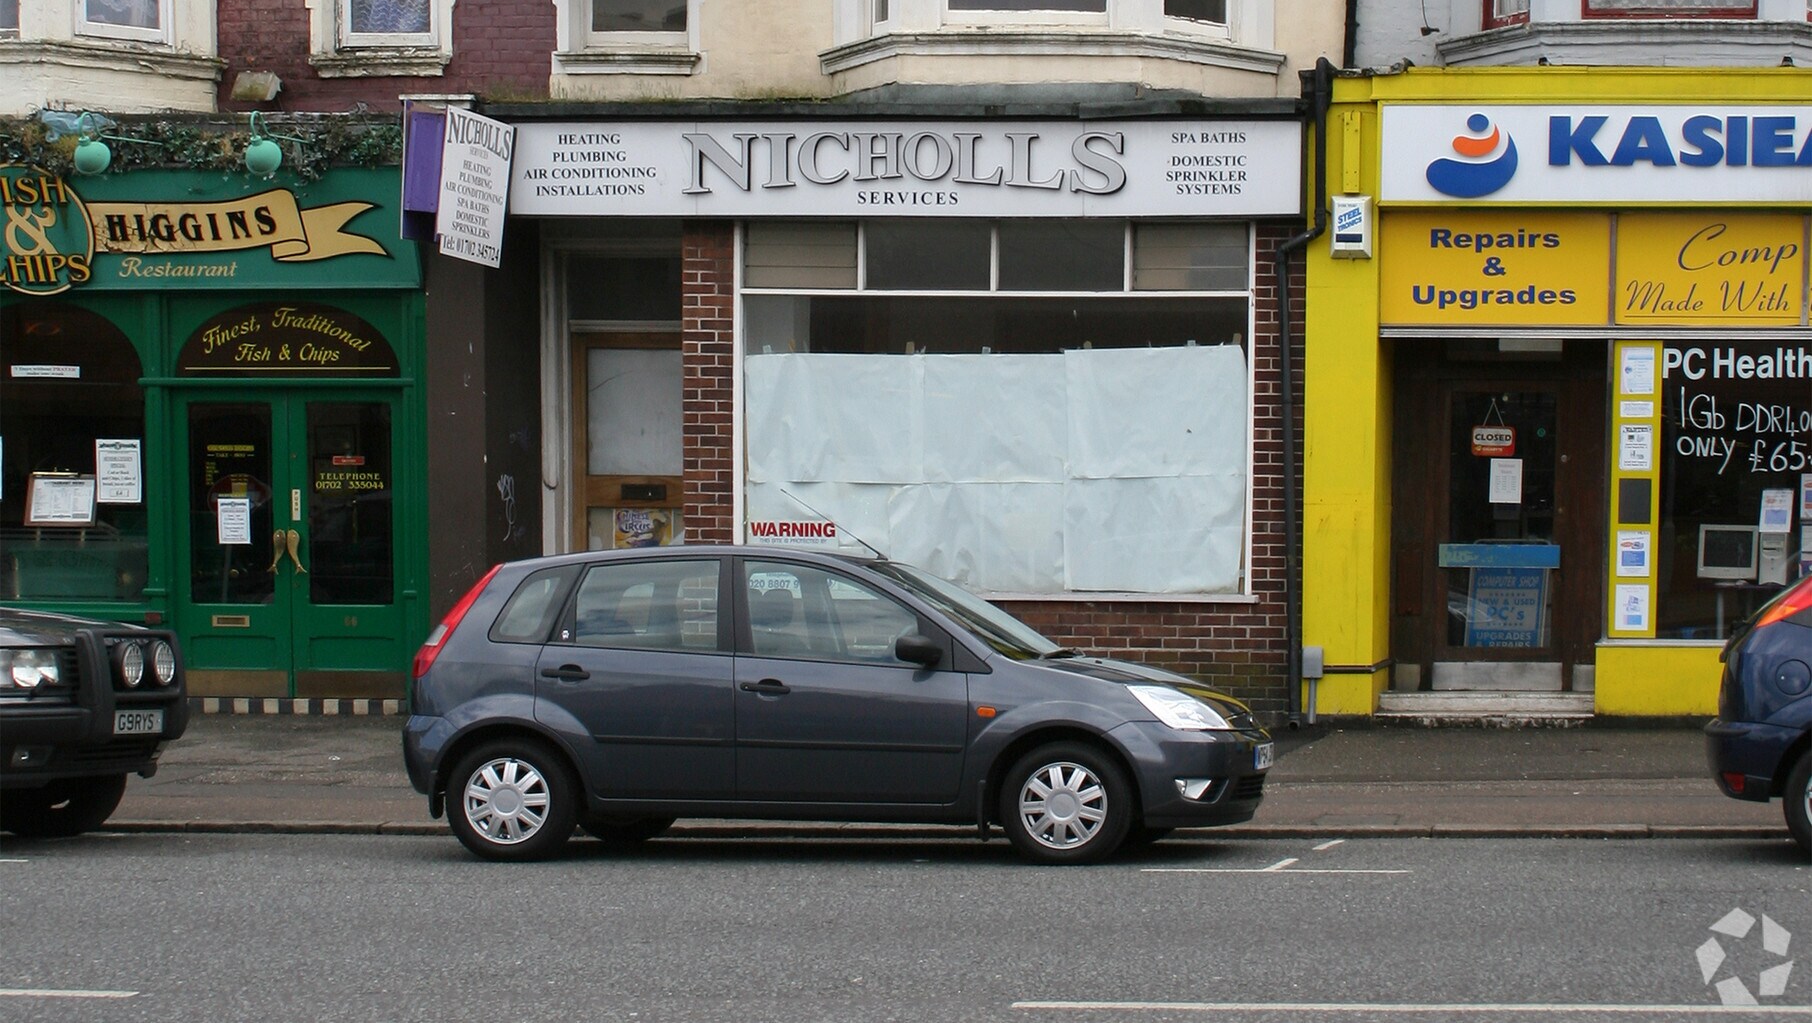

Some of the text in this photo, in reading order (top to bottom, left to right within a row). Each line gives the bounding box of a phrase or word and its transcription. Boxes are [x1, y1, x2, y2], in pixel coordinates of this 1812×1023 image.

[447, 112, 512, 162] NICHOLLS
[558, 134, 621, 145] HEATING
[1171, 132, 1247, 143] SPA BATHS
[1549, 115, 1812, 167] KASIE
[553, 151, 627, 163] PLUMBING
[681, 131, 1127, 195] NICHOLLS
[1171, 156, 1248, 166] DOMESTIC
[463, 160, 492, 176] HEATING
[523, 167, 657, 180] AIR CONDITIONING
[1166, 171, 1247, 182] SPRINKLER
[459, 172, 492, 190] PLUMBING
[1176, 184, 1242, 195] SYSTEMS
[445, 181, 503, 206] AIR CONDITIONING
[536, 184, 646, 196] INSTALLATIONS
[857, 190, 960, 206] SERVICES
[457, 198, 490, 214] SPA BATHS
[105, 205, 277, 242] HIGGINS
[456, 210, 489, 227] DOMESTIC
[1338, 207, 1362, 224] STEEL
[5, 204, 58, 256] &
[452, 222, 490, 239] SPRINKLERS
[443, 235, 455, 250] Tel:
[1430, 228, 1560, 253] Repairs
[1678, 223, 1798, 274] Comp
[0, 254, 91, 283] HIPS
[119, 257, 238, 277] Restaurant
[1482, 257, 1507, 276] &
[1412, 285, 1576, 309] Upgrades
[1626, 280, 1790, 314] Made With
[202, 307, 372, 354] Finest, Traditional
[235, 343, 340, 364] Fish & Chips
[1662, 347, 1706, 380] PC
[1681, 386, 1812, 437] 1Gb DDR40
[1474, 433, 1512, 442] CLOSED
[1676, 436, 1812, 475] ONLY £65.
[315, 481, 341, 489] 01702
[751, 522, 836, 537] WARNING
[768, 579, 790, 588] 8807
[1476, 632, 1531, 640] UPGRADES
[119, 714, 154, 731] G9RYS
